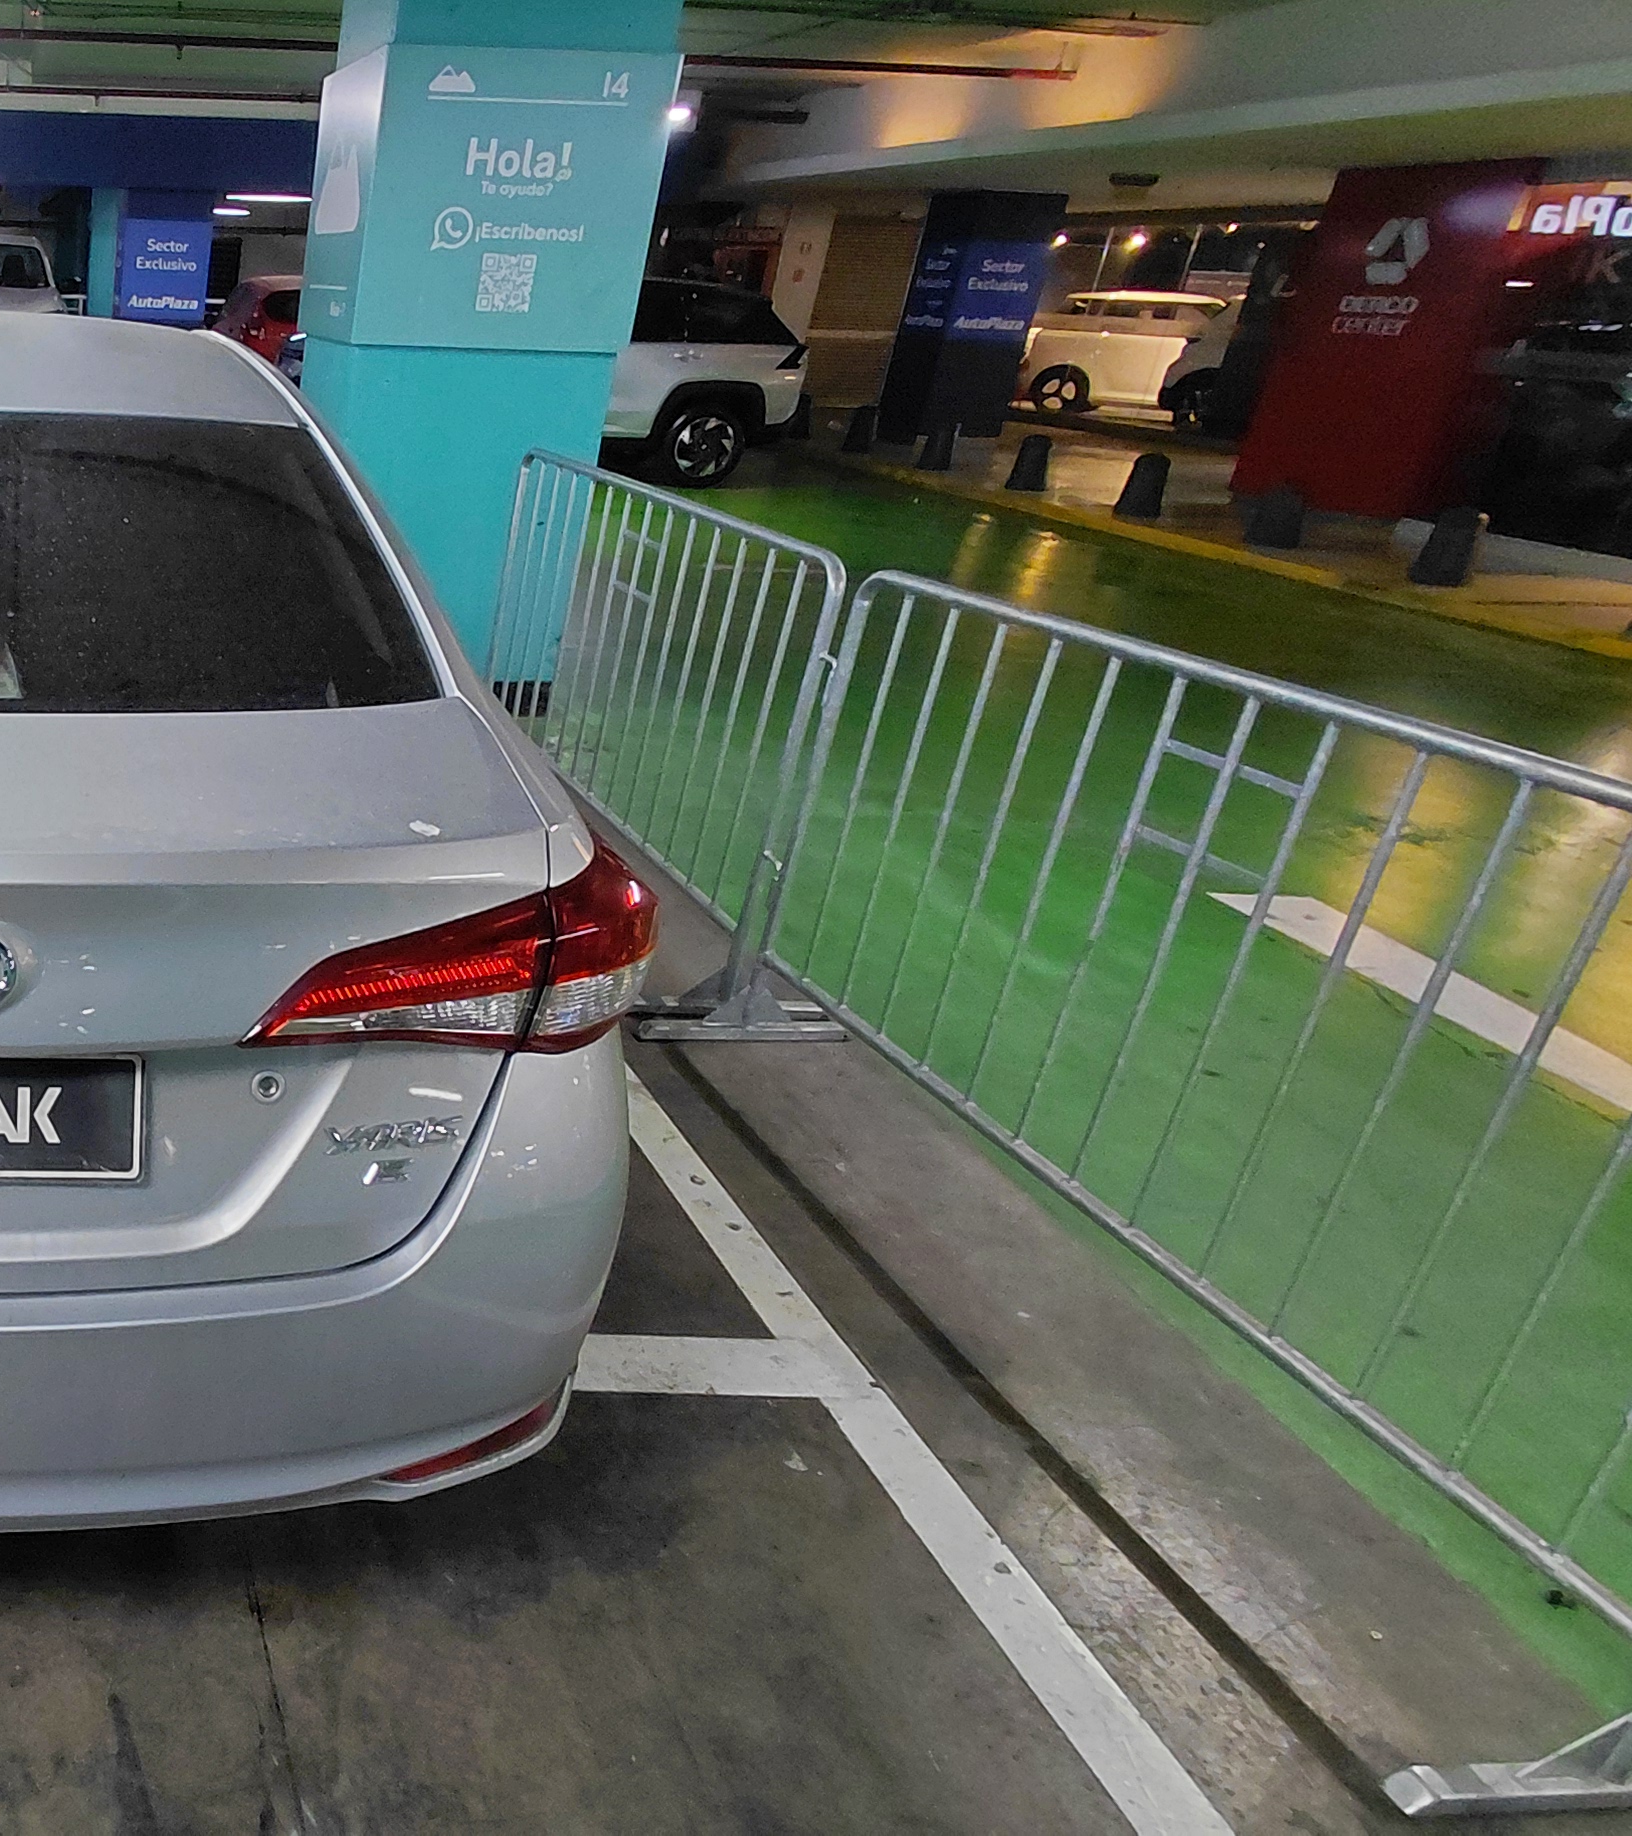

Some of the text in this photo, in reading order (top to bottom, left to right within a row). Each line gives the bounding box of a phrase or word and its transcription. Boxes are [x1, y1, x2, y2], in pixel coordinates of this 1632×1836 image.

[602, 71, 629, 98] 14
[465, 136, 573, 181] Hola!
[147, 238, 189, 252] Sector
[136, 256, 197, 271] Exclusivo
[128, 294, 198, 310] AutoPlaza
